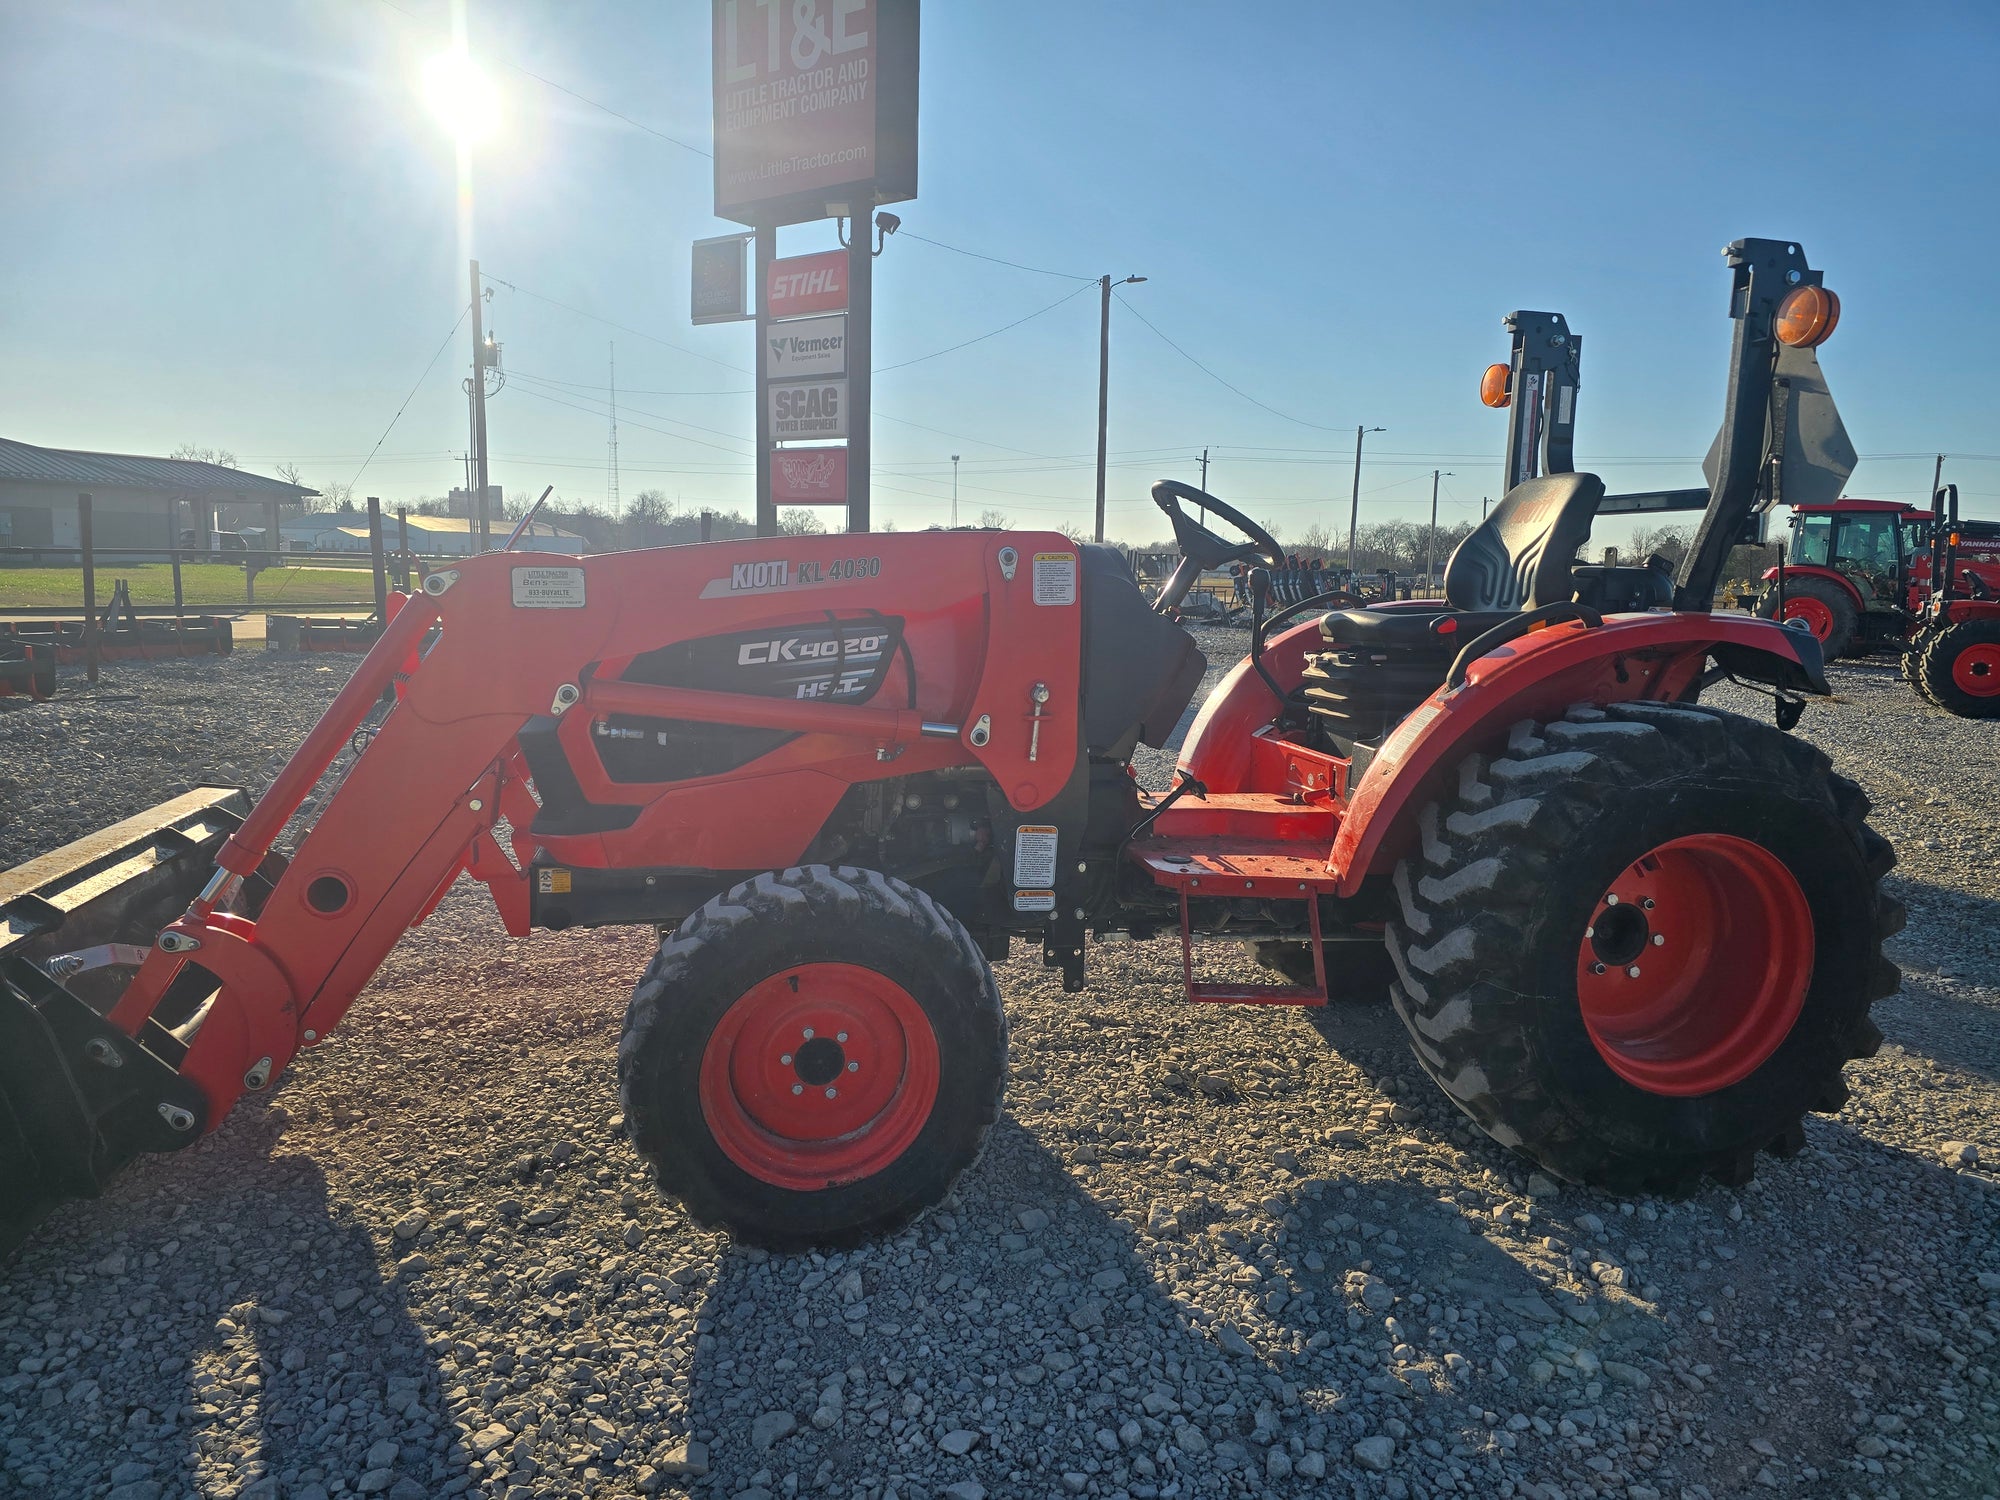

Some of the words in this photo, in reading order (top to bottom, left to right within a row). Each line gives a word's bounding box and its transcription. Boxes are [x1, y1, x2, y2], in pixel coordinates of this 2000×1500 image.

[725, 0, 868, 84] LT&E
[725, 85, 767, 112] LITTLE
[771, 68, 834, 100] TRACTOR
[838, 59, 868, 83] AND
[726, 97, 797, 132] EQUIPMENT
[801, 81, 867, 114] COMPANY
[728, 145, 866, 185] www.LittleTractor.com
[771, 267, 840, 299] STIHL
[789, 336, 843, 353] Vermeer
[791, 354, 817, 362] Equipment
[775, 387, 838, 419] SCAG
[776, 420, 798, 432] POWER
[800, 418, 838, 431] EQUIPMENT
[731, 560, 788, 590] KIOTI
[797, 562, 824, 585] KL
[828, 556, 882, 581] 4030
[737, 635, 881, 666] CK4020
